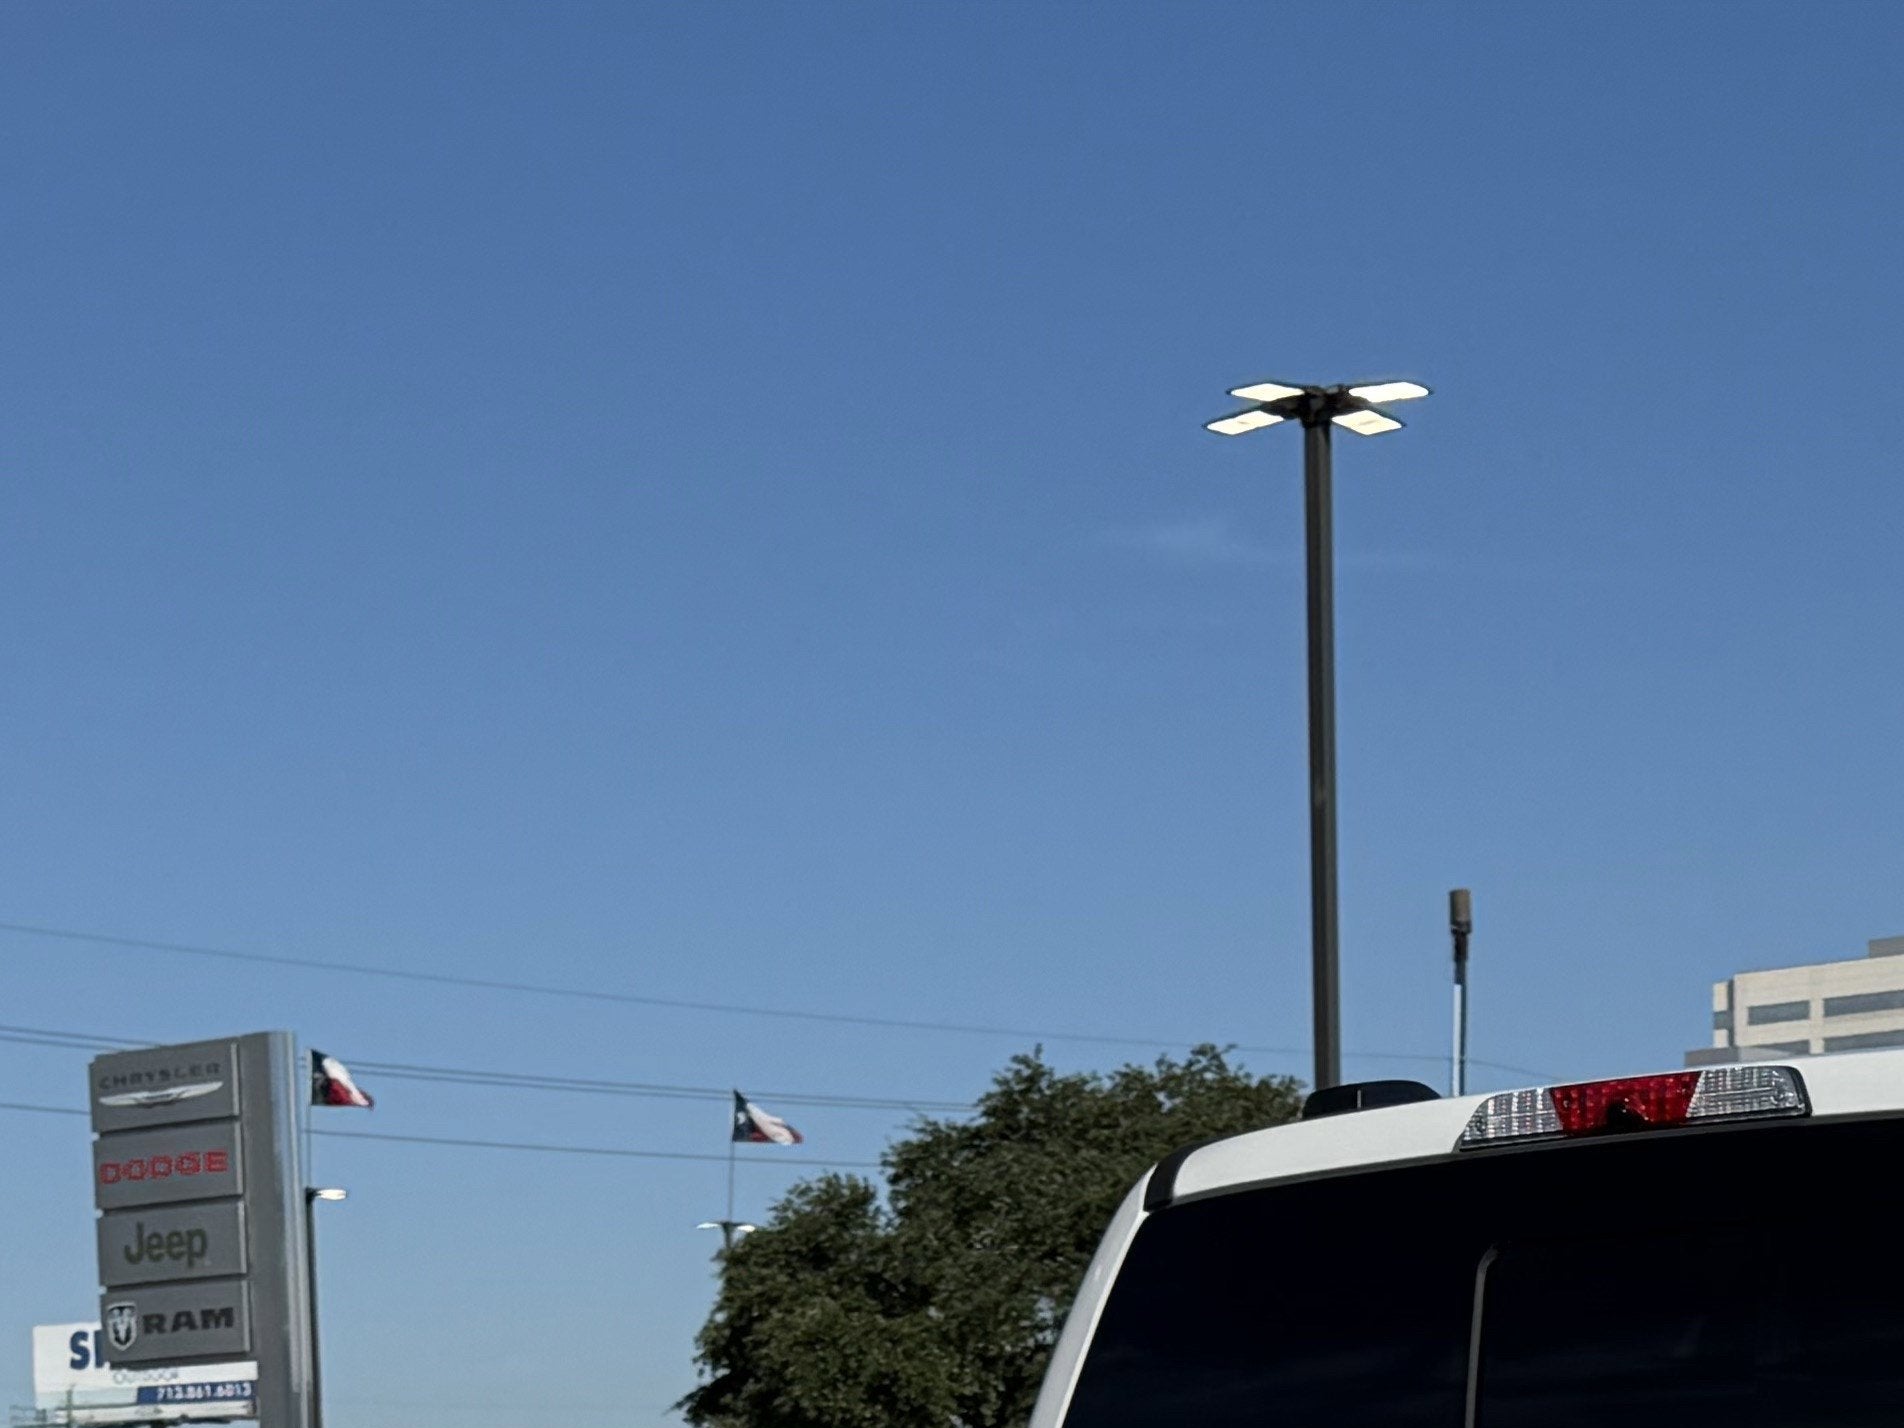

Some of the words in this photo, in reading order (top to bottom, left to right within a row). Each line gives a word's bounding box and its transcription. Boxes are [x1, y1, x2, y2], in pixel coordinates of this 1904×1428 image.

[100, 1150, 230, 1185] DODGE
[124, 1222, 209, 1270] Jeep
[143, 1306, 234, 1334] RAM
